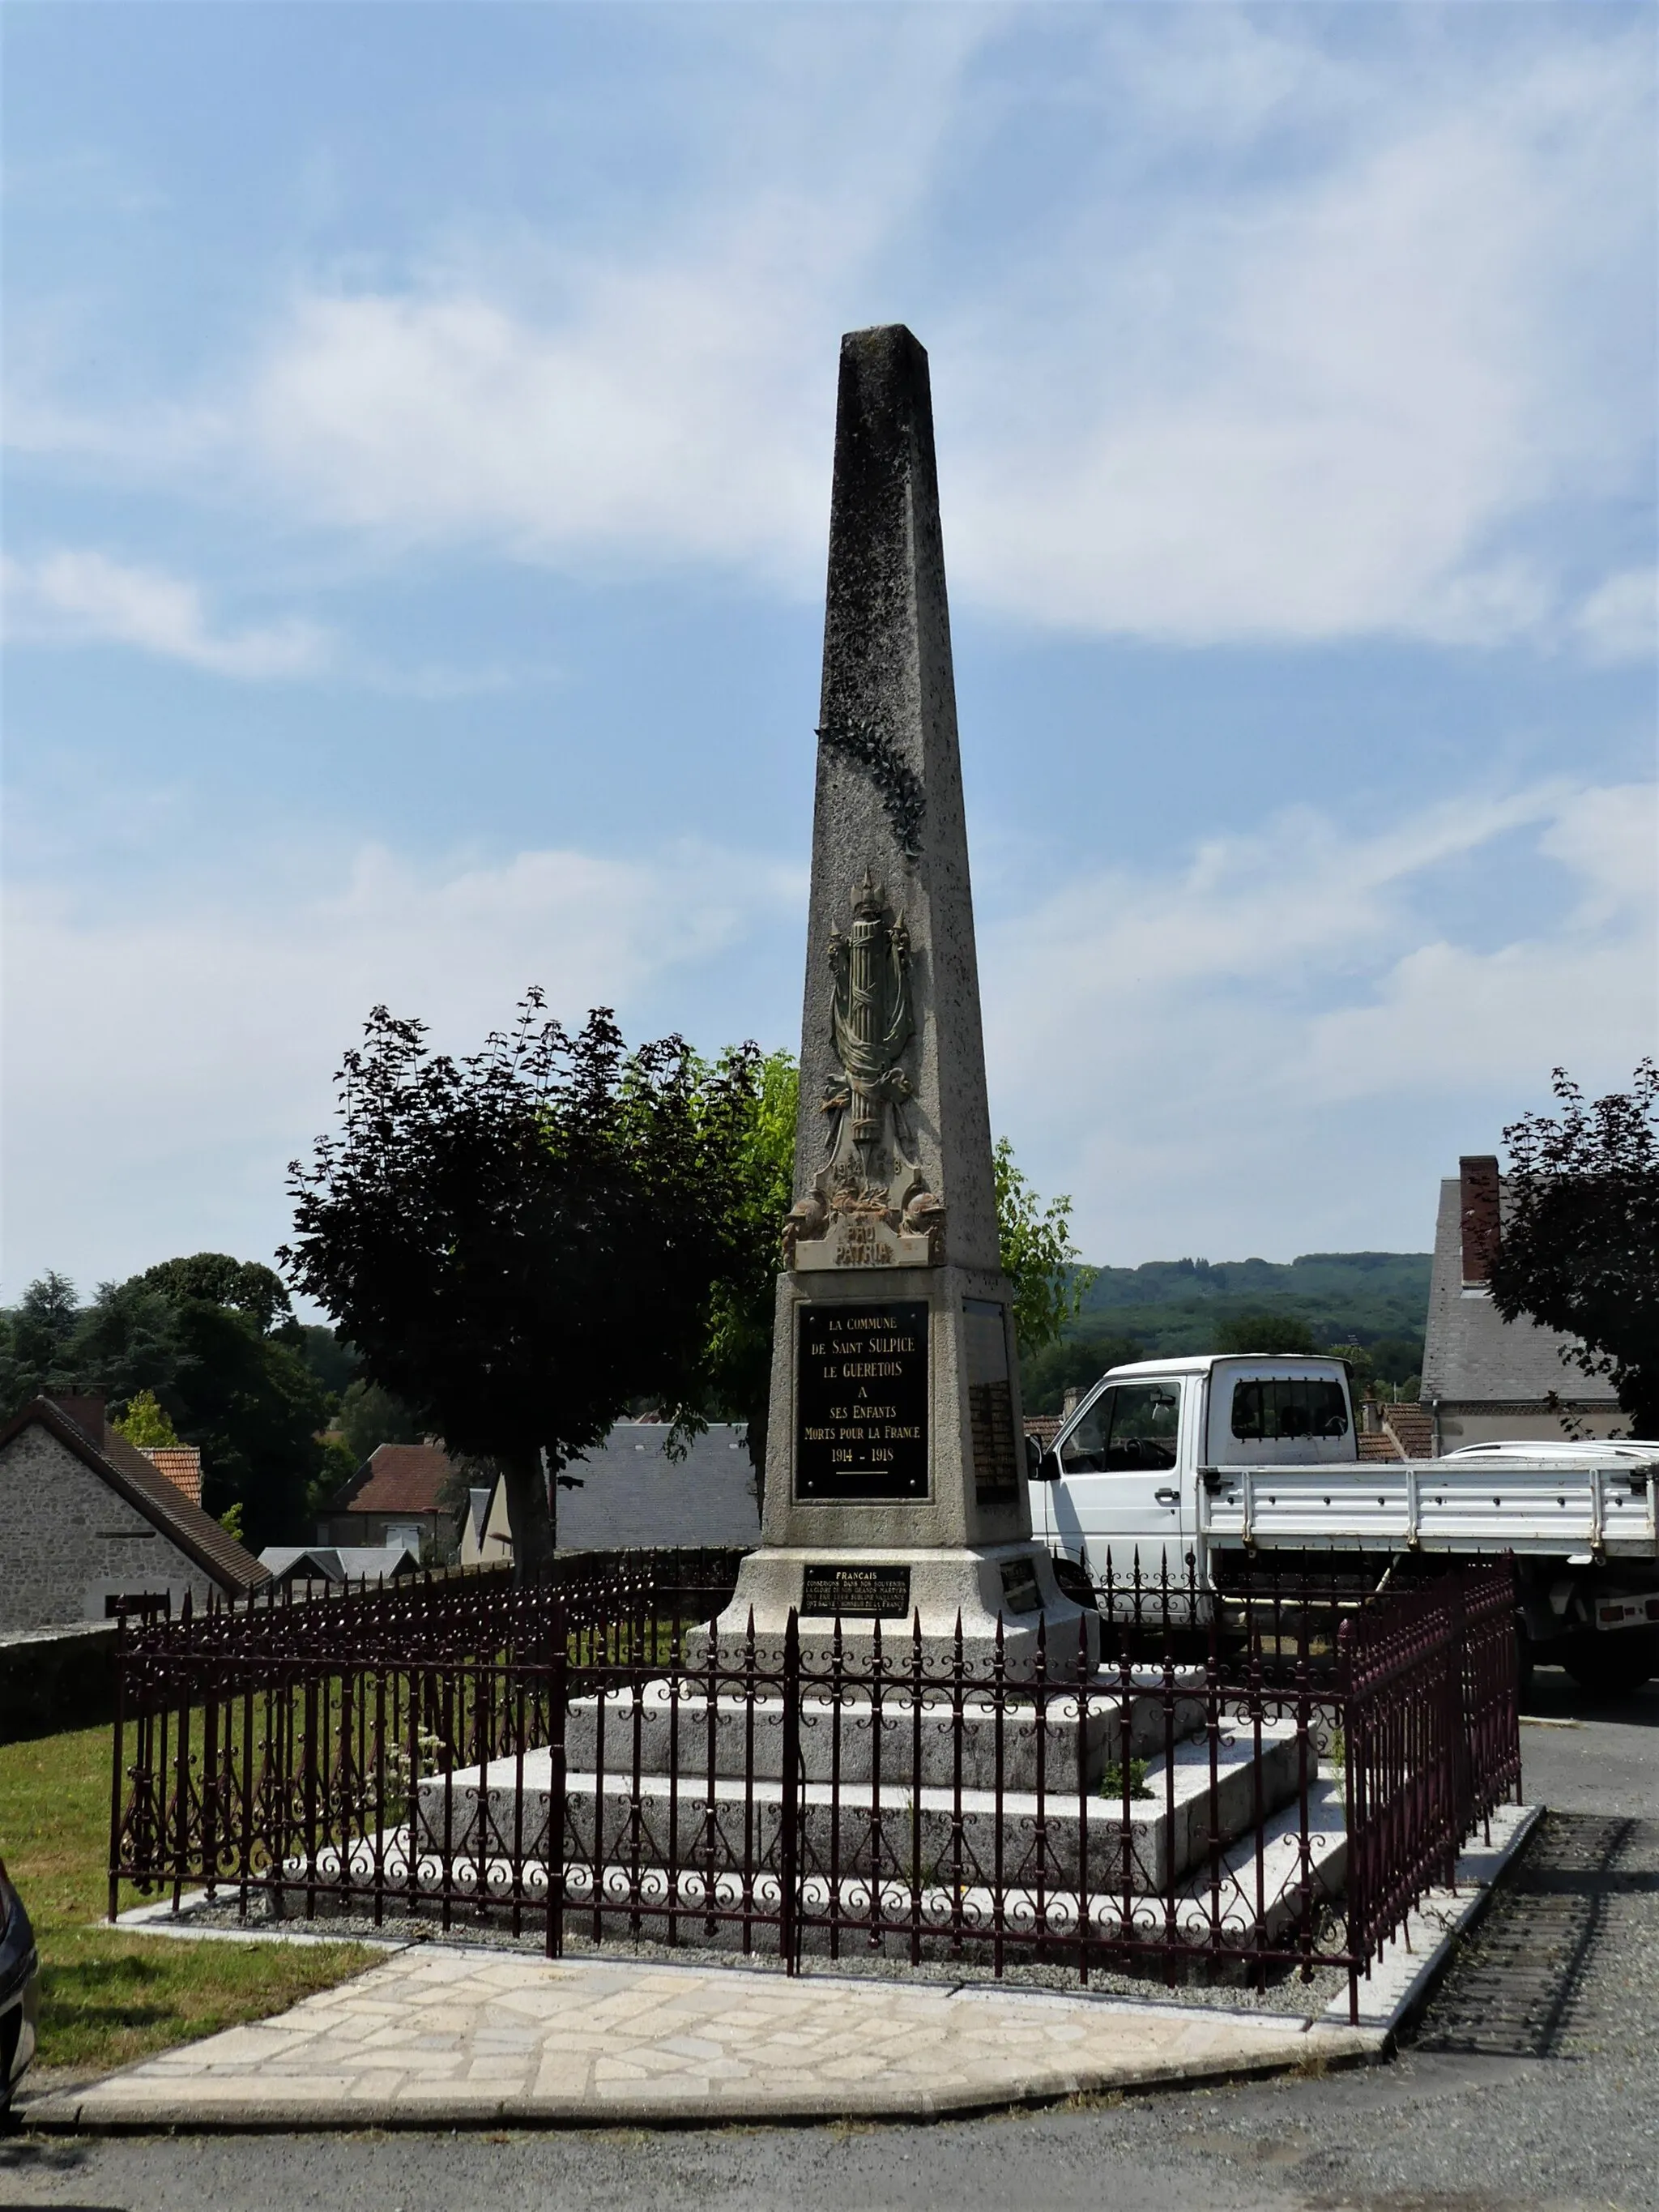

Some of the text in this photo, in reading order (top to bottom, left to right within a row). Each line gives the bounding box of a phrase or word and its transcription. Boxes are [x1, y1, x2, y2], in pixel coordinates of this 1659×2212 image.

[847, 1225, 876, 1242] PRO
[835, 1243, 891, 1264] PATRIA
[830, 1317, 898, 1330] LA COMMUNE
[812, 1337, 915, 1355] DE SAINT SULPICE
[823, 1361, 902, 1378] LE GUERETOIS
[858, 1386, 868, 1398] A
[830, 1405, 897, 1419] SES ENFANTS
[804, 1425, 920, 1440] MORTS POUR LA FRANCE
[831, 1449, 852, 1462] 1914
[871, 1448, 894, 1462] 1918
